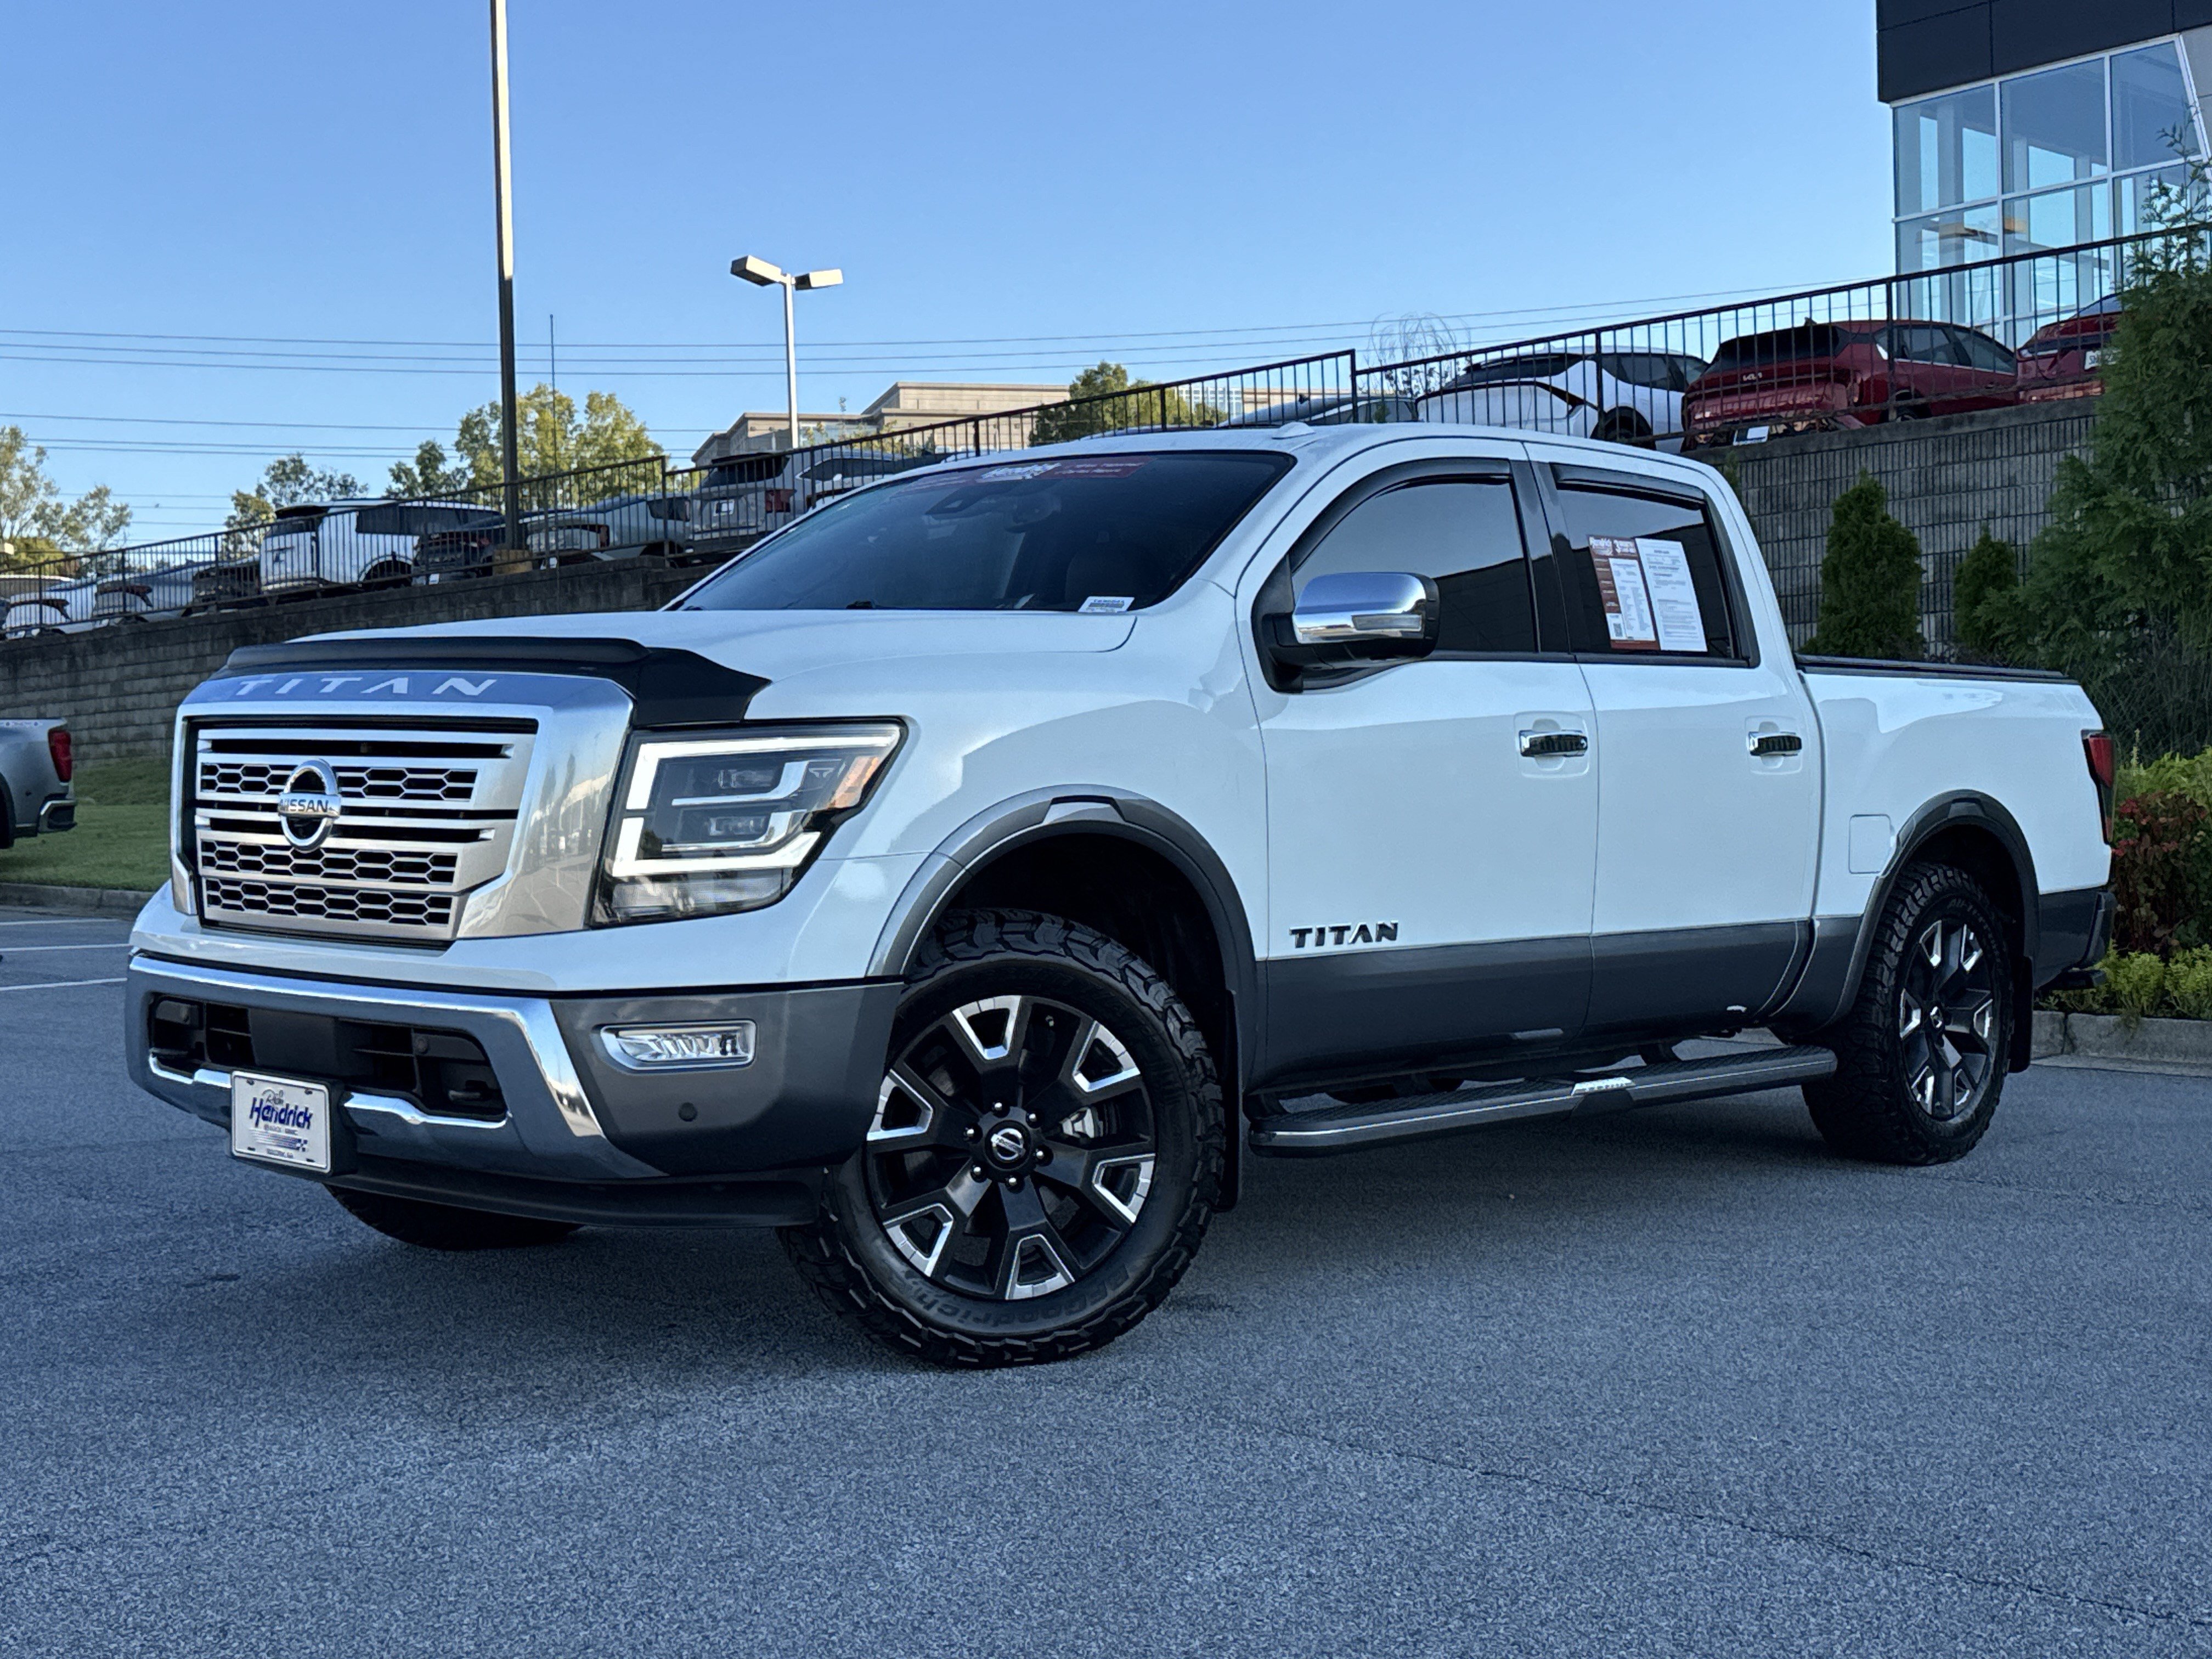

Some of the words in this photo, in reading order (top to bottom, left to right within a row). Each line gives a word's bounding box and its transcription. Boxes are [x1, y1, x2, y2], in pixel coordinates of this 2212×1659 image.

[235, 676, 497, 696] TITAN
[279, 798, 329, 812] NISSAN
[1289, 920, 1398, 949] TITAN
[249, 1097, 313, 1130] Hendrick
